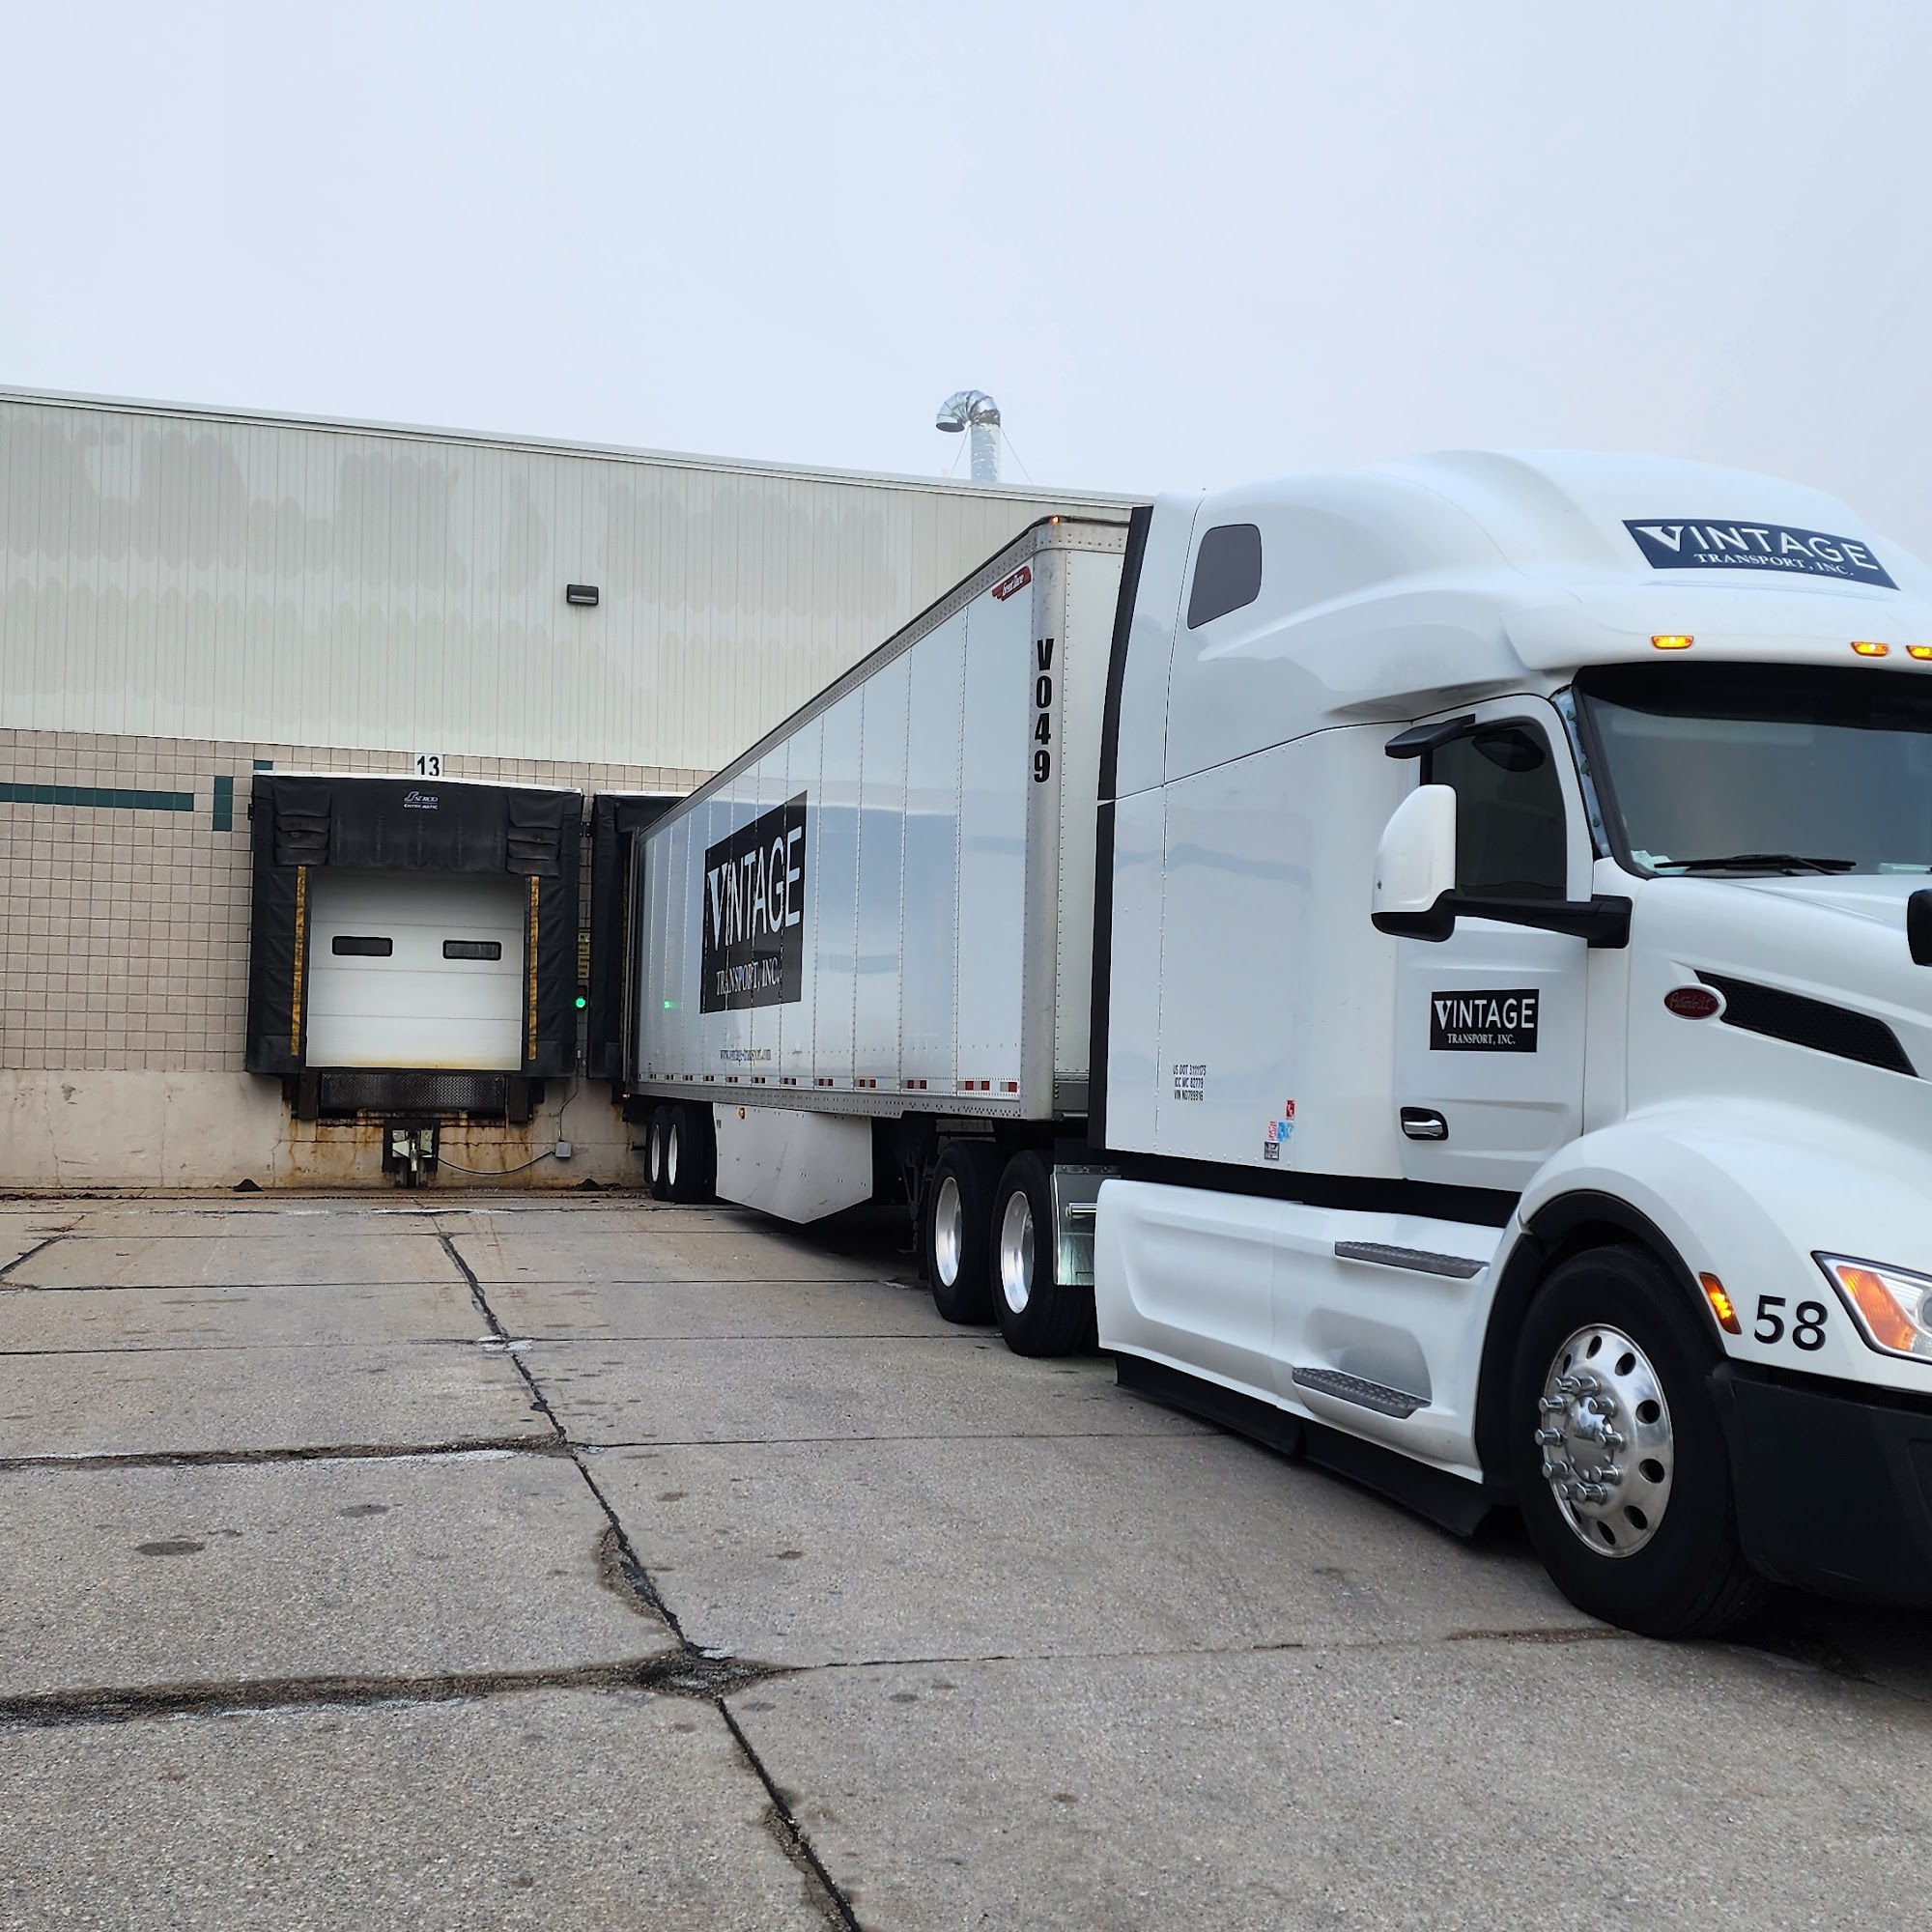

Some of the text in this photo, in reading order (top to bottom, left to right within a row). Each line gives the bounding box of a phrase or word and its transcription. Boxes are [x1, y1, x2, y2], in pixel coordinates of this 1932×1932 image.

[1634, 525, 1880, 571] VINTAGE
[1815, 561, 1854, 577] INC.
[416, 755, 440, 777] 13
[707, 825, 803, 952] VINTAGE
[716, 956, 780, 996] TRANSPORT, INC.
[1434, 998, 1536, 1031] VINTAGE
[1447, 1033, 1517, 1046] TRANSPORT, INC.
[1753, 1293, 1829, 1351] 58
